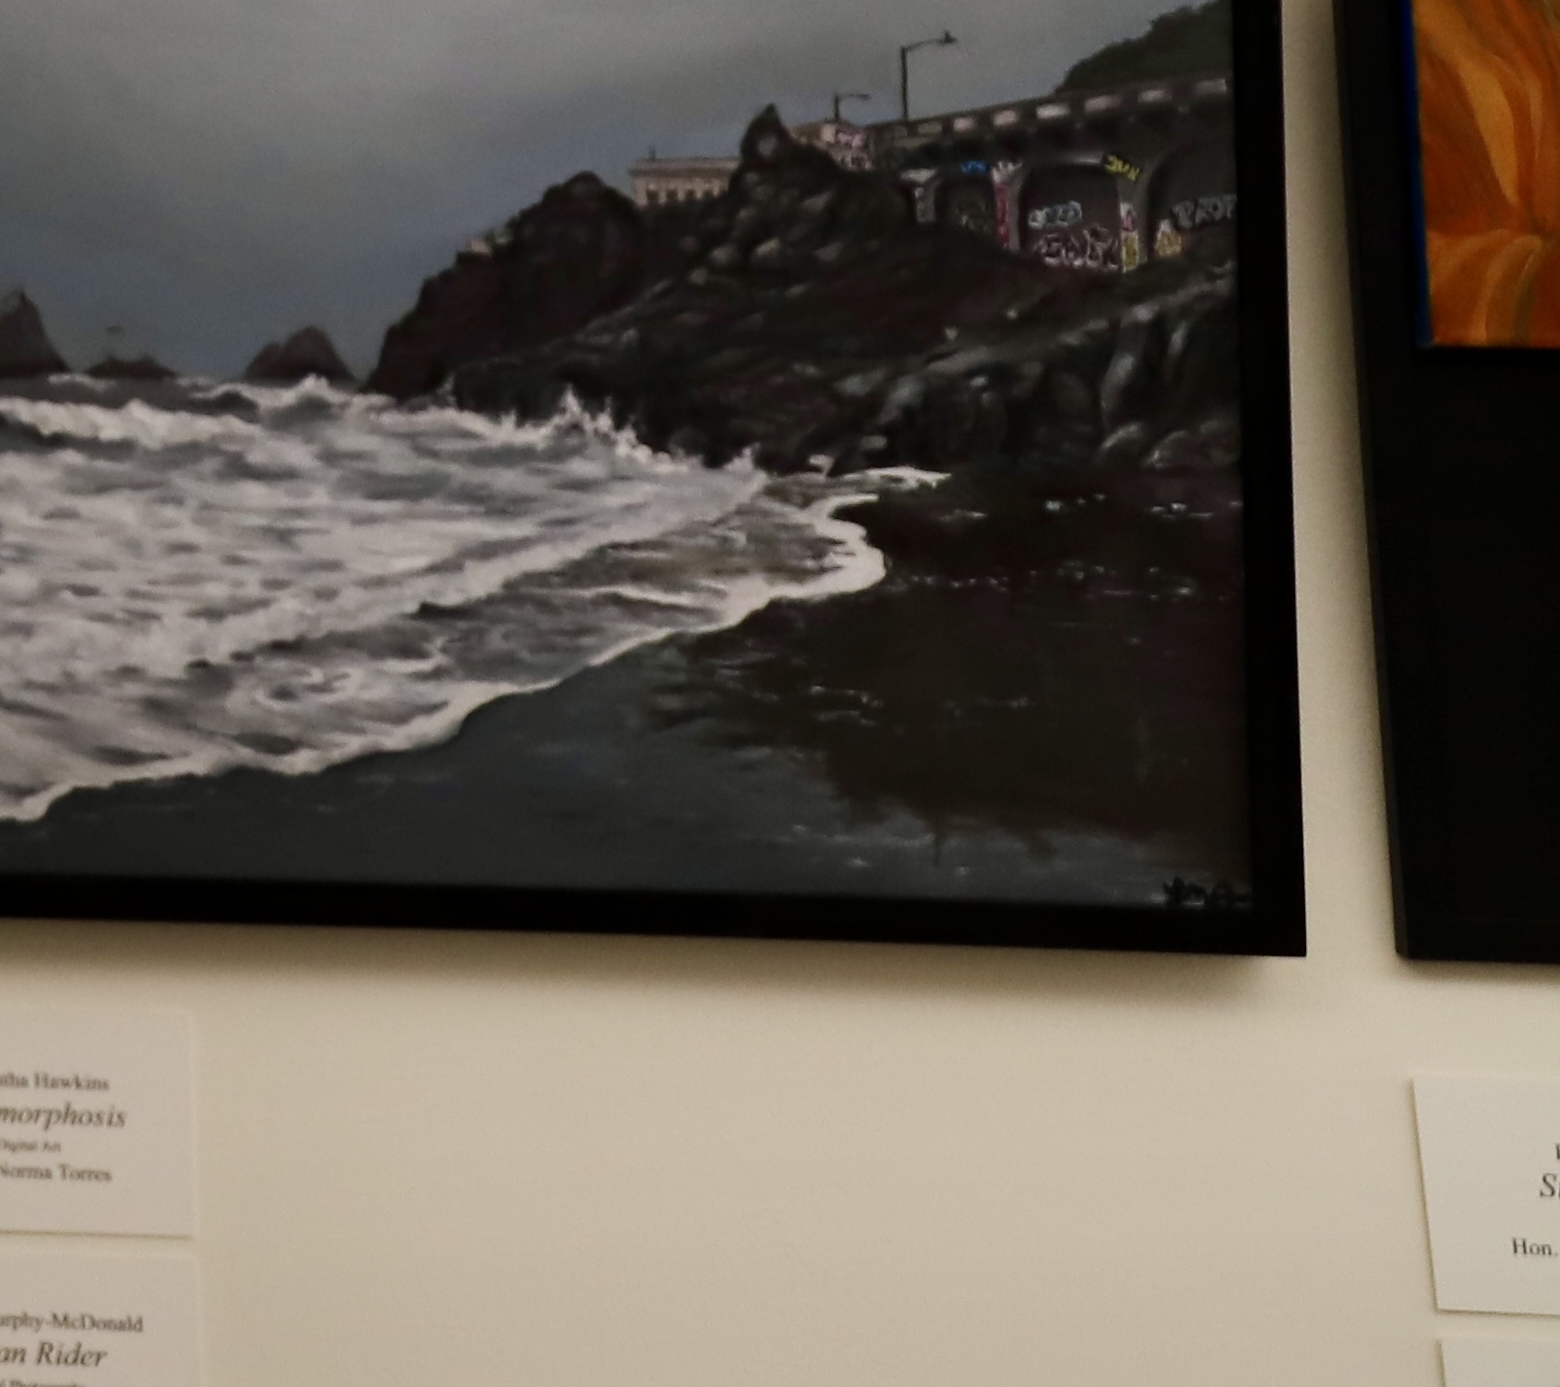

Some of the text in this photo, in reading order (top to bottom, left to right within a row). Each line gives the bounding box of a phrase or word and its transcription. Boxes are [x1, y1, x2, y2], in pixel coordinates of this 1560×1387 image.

[34, 1071, 110, 1091] Hawkins
[59, 1163, 112, 1181] Torres
[1512, 1237, 1558, 1256] Hon.
[36, 1341, 109, 1367] Rider
